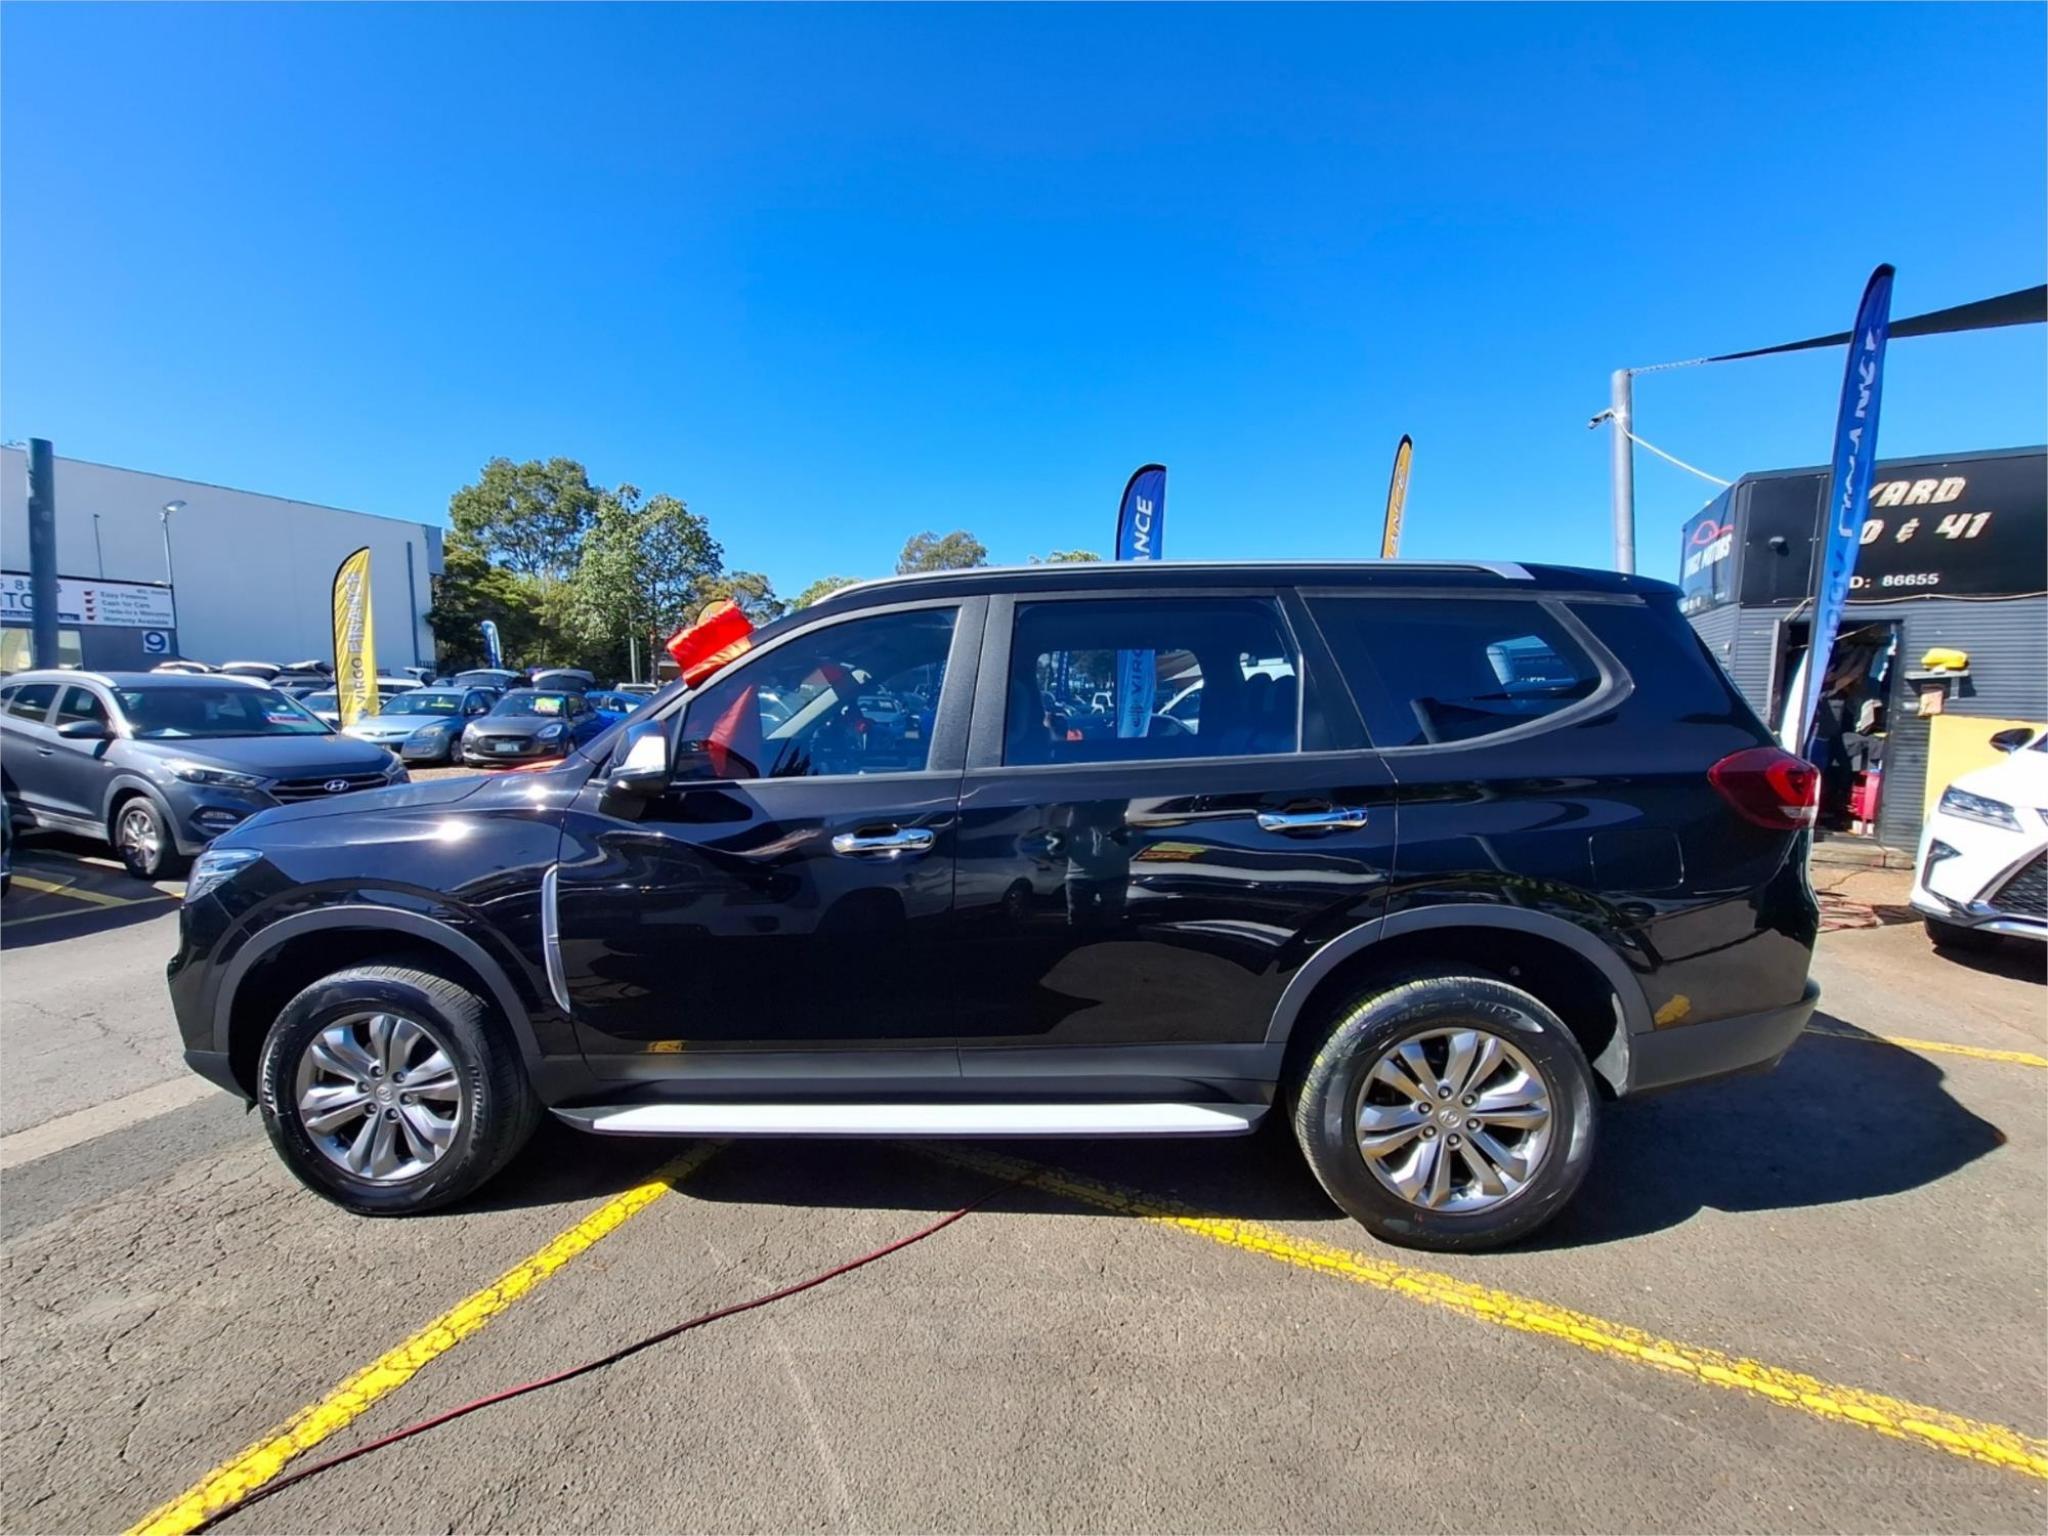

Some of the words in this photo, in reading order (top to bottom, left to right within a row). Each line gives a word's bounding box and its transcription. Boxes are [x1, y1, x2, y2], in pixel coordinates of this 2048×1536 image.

[1130, 496, 1153, 561] NCE
[1933, 511, 1993, 540] 41
[1881, 572, 1941, 588] 86655
[144, 631, 167, 652] 9
[351, 656, 367, 705] VIRGO
